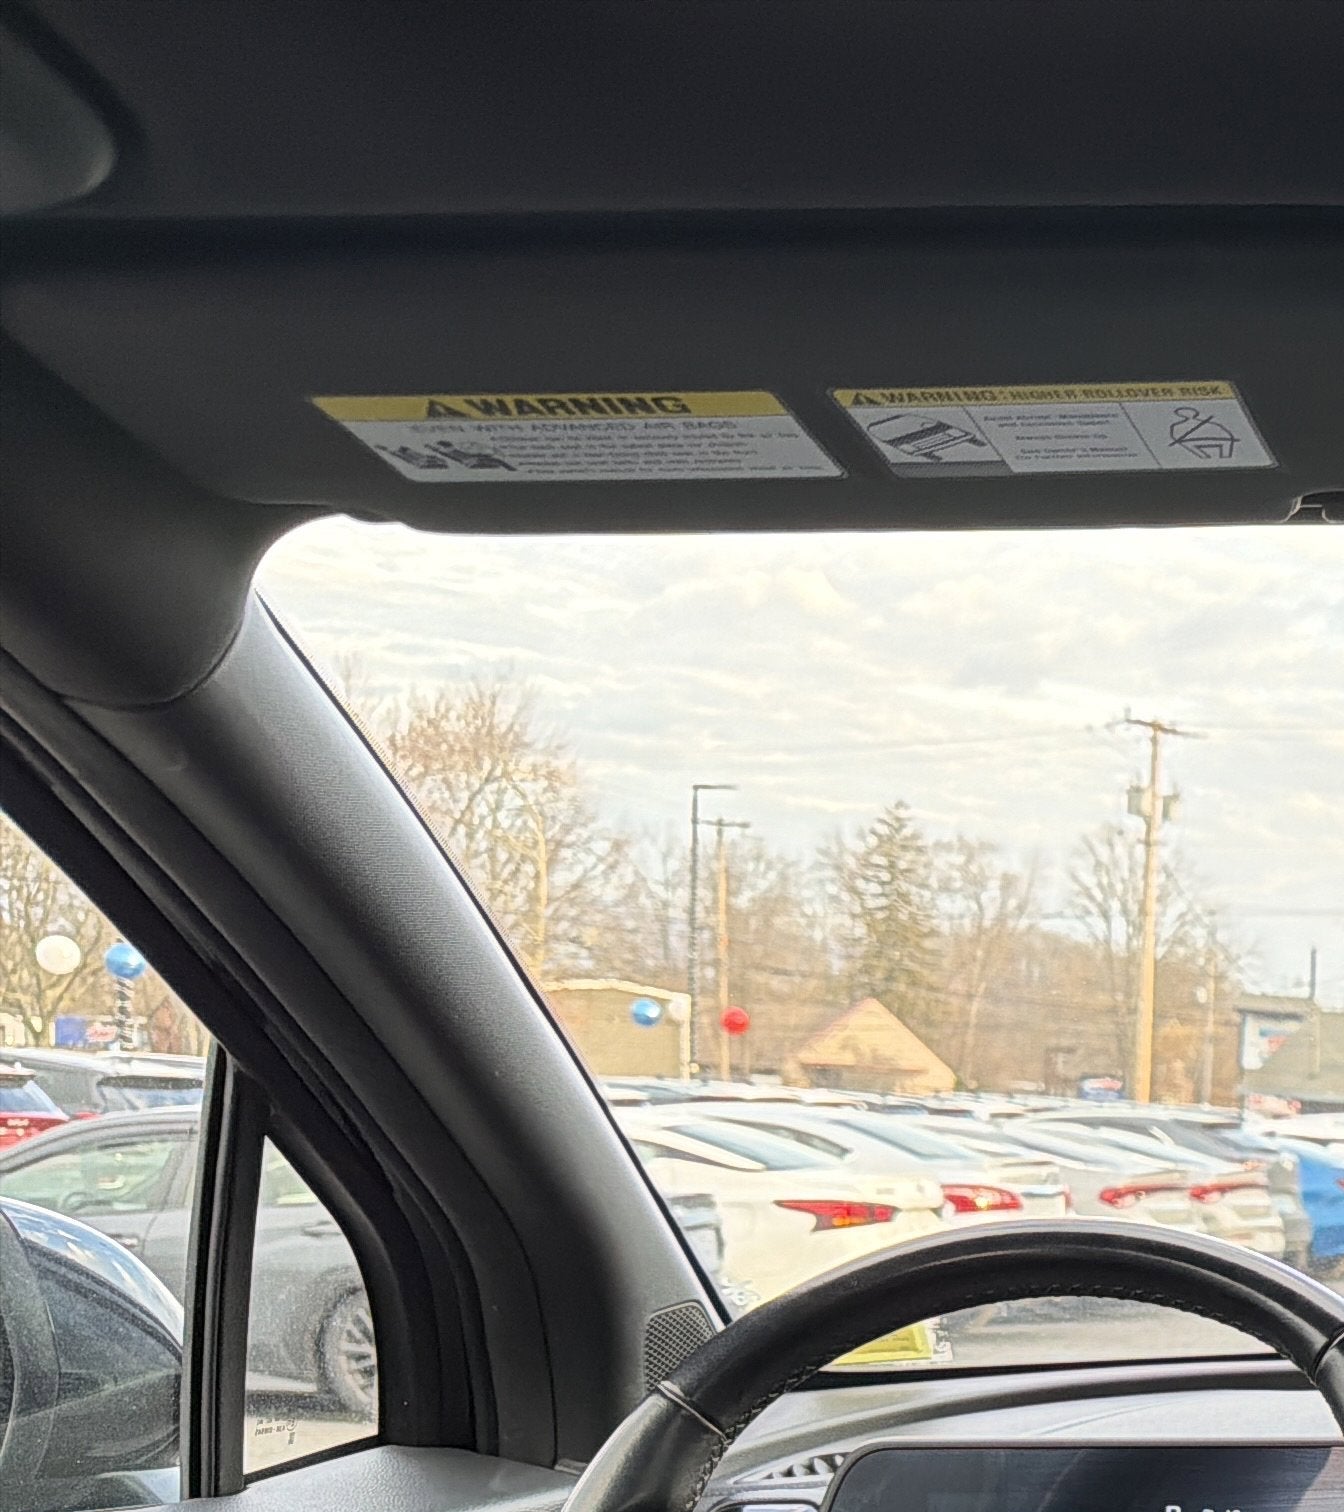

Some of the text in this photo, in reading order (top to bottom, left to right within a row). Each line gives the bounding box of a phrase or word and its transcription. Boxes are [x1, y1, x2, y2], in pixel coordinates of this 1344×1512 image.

[1009, 388, 1078, 401] HIGHER
[1082, 386, 1175, 400] ROLLOVER
[1180, 385, 1222, 398] RISK
[463, 396, 692, 416] WARNING
